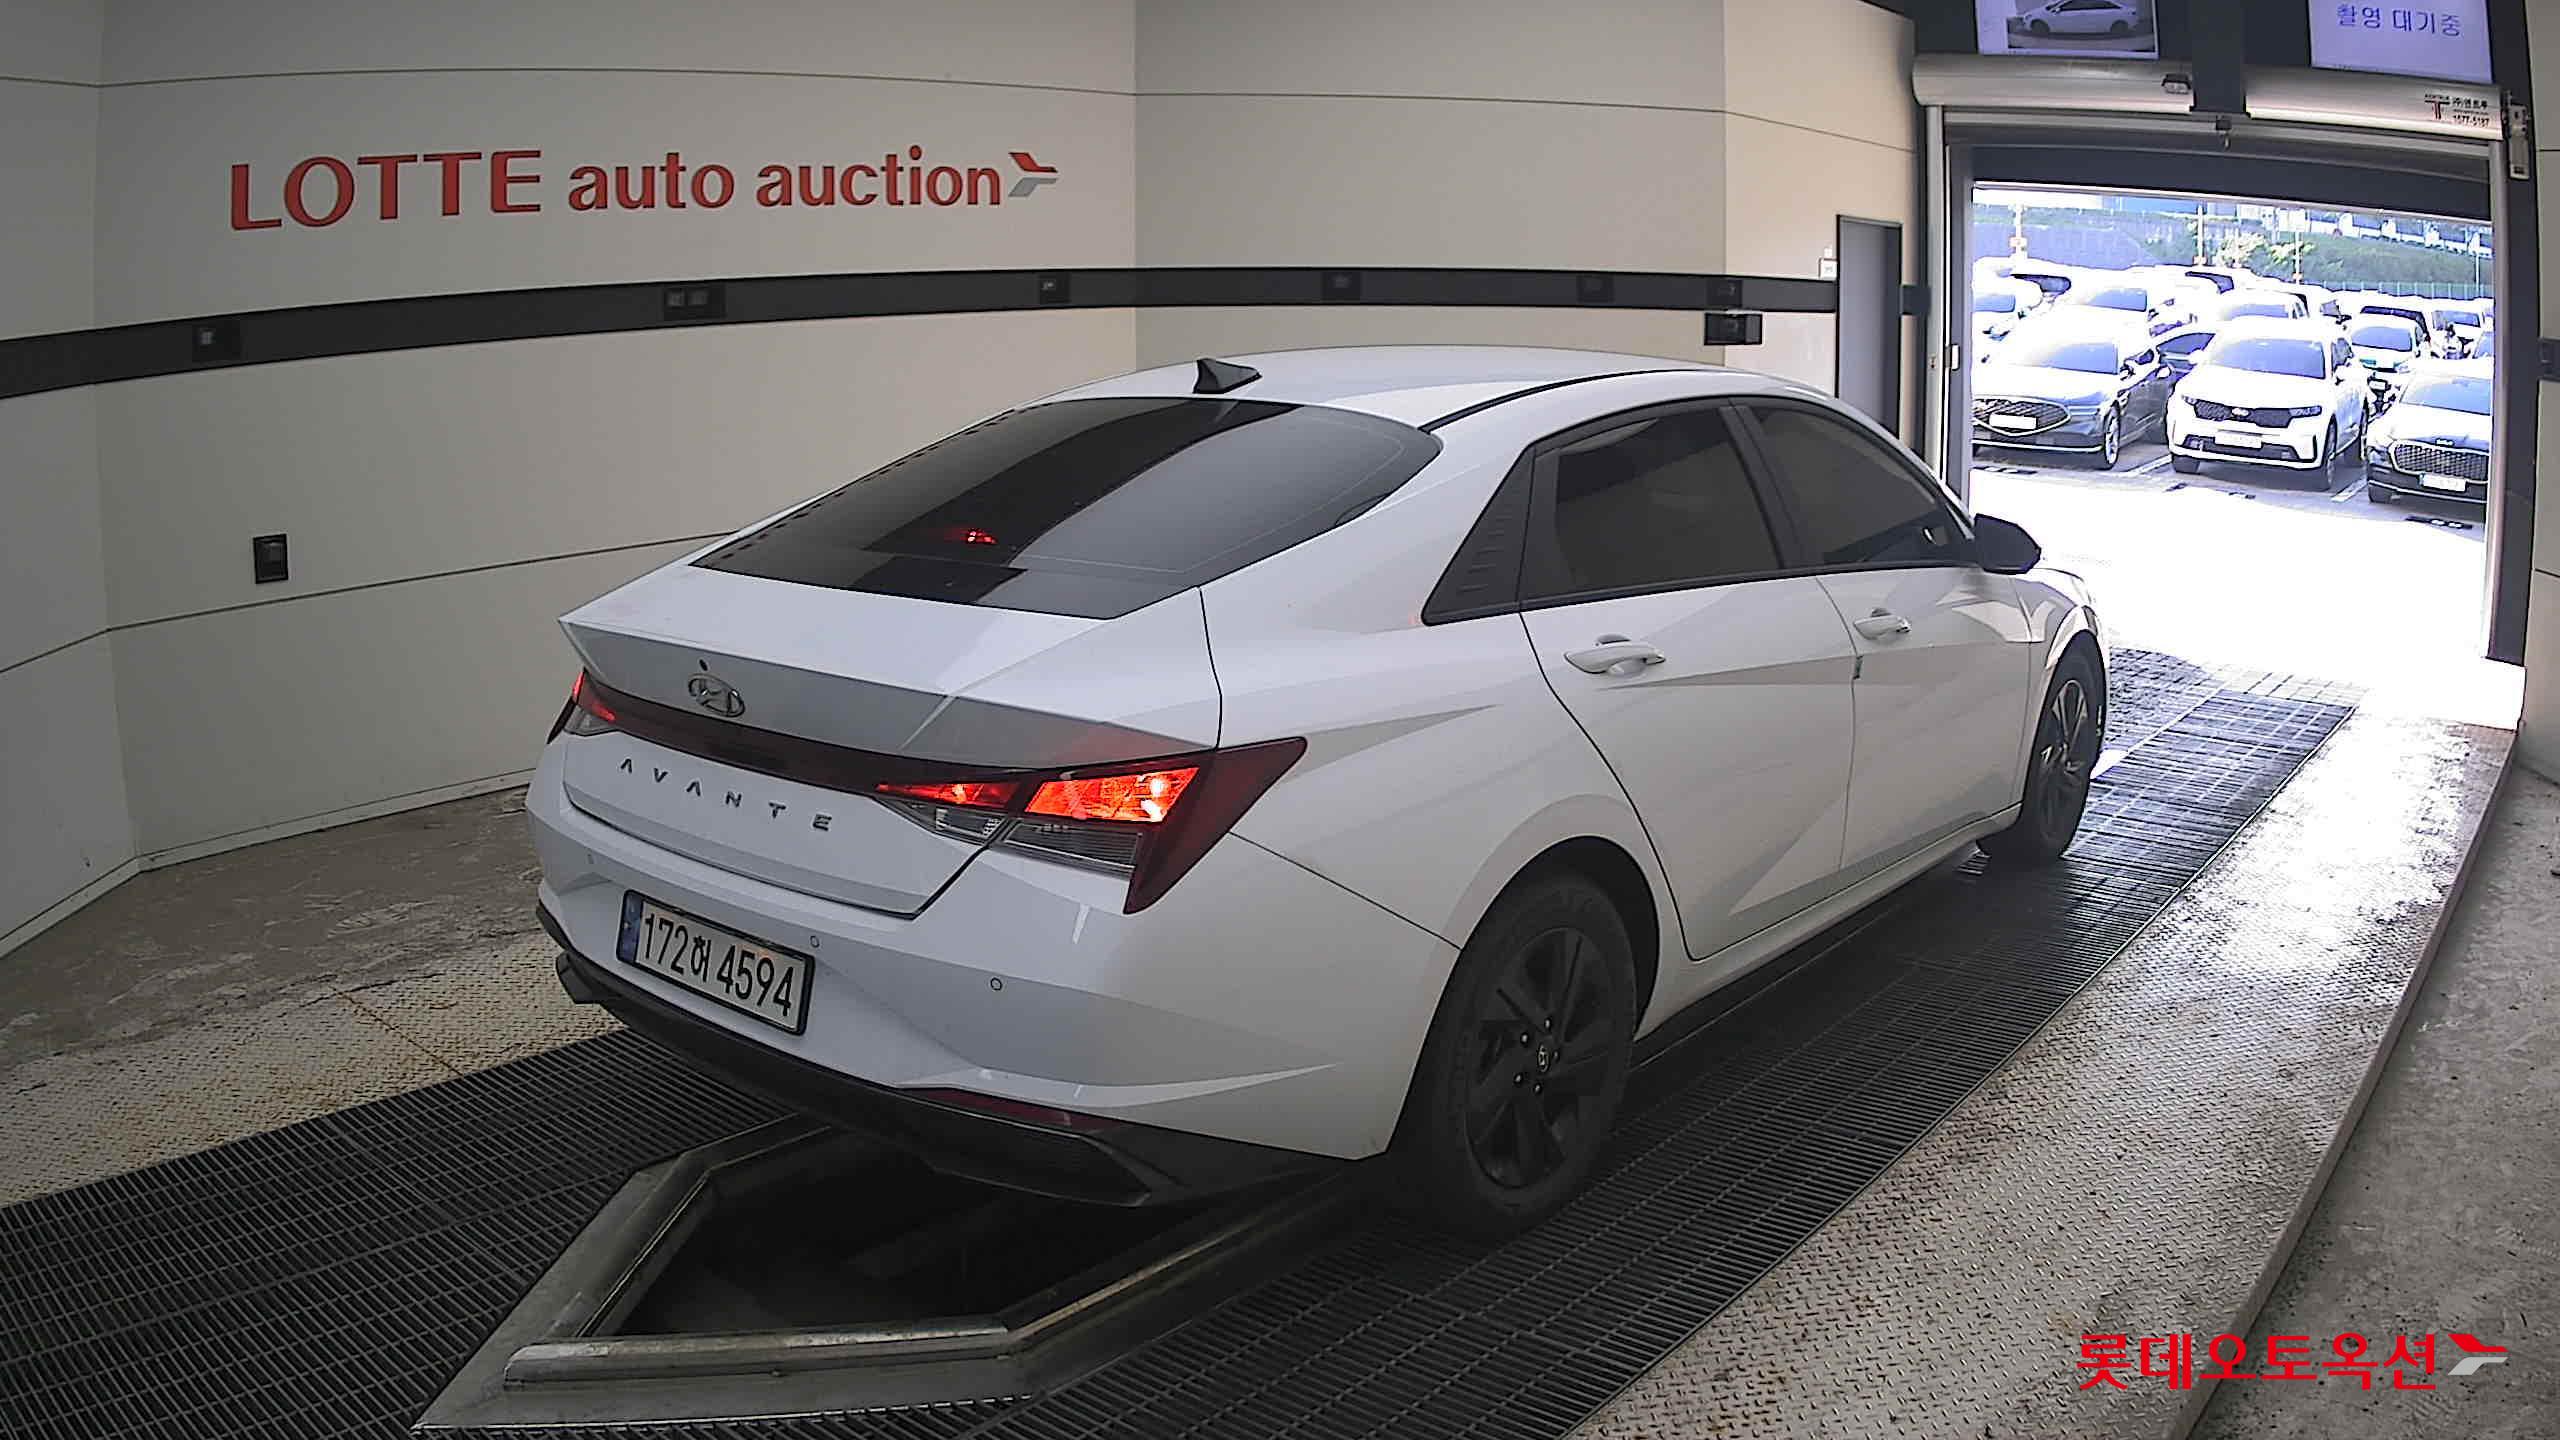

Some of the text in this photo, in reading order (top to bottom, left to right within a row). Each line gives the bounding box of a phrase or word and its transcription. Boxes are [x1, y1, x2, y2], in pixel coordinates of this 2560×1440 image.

[2338, 5, 2460, 37] 촬영 대기중
[230, 145, 1002, 231] LOTTE auto auction
[619, 757, 833, 832] AVANTE
[715, 944, 795, 1017] 4594
